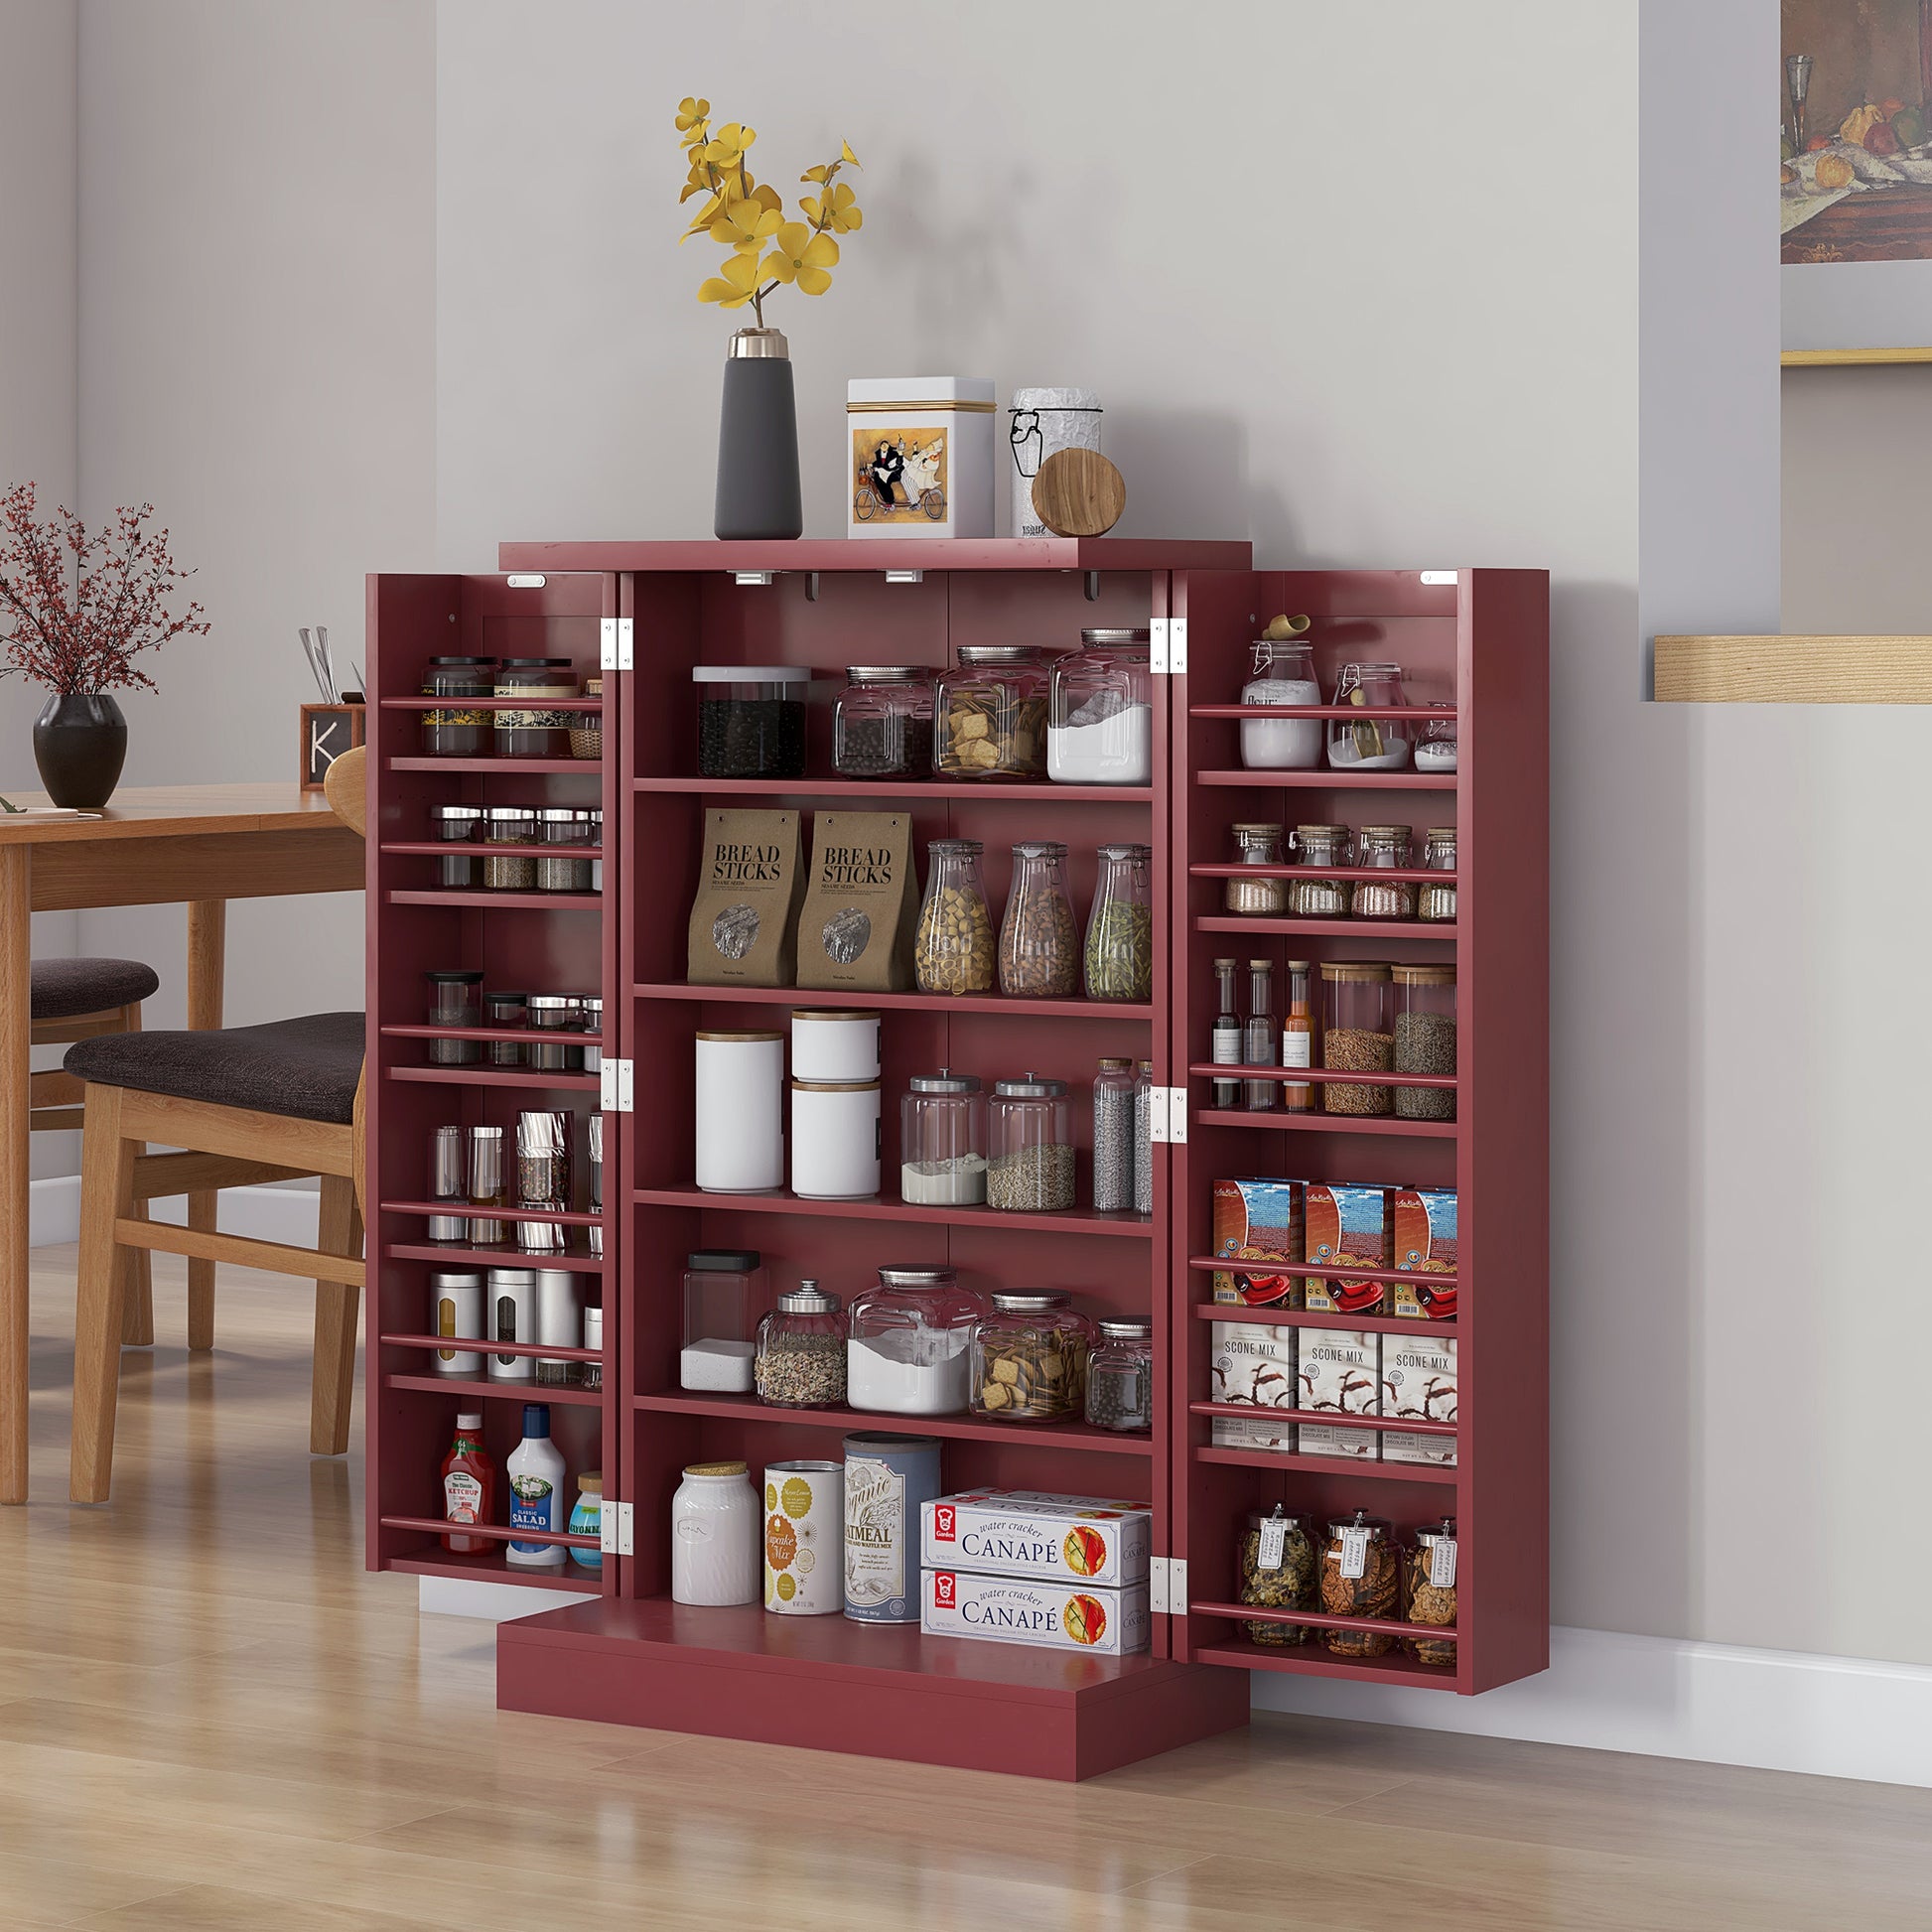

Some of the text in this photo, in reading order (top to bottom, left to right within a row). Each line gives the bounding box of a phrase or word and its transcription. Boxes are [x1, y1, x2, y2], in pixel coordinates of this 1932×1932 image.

[311, 720, 338, 773] K
[715, 844, 780, 863] BREAD
[823, 847, 892, 866] BREAD
[713, 862, 780, 880] STICKS
[822, 865, 892, 884] STICKS
[1225, 1341, 1276, 1356] SCONE MIX
[1311, 1347, 1363, 1363] SCONE MIX
[1396, 1354, 1449, 1369] SCONE MIX
[512, 1514, 547, 1526] SALAD
[845, 1524, 893, 1542] ATMEAL
[979, 1521, 1043, 1539] water cracker
[962, 1534, 1058, 1564] CANAPÉ
[979, 1588, 1043, 1606] water cracker
[962, 1601, 1058, 1631] CANAPÉ
